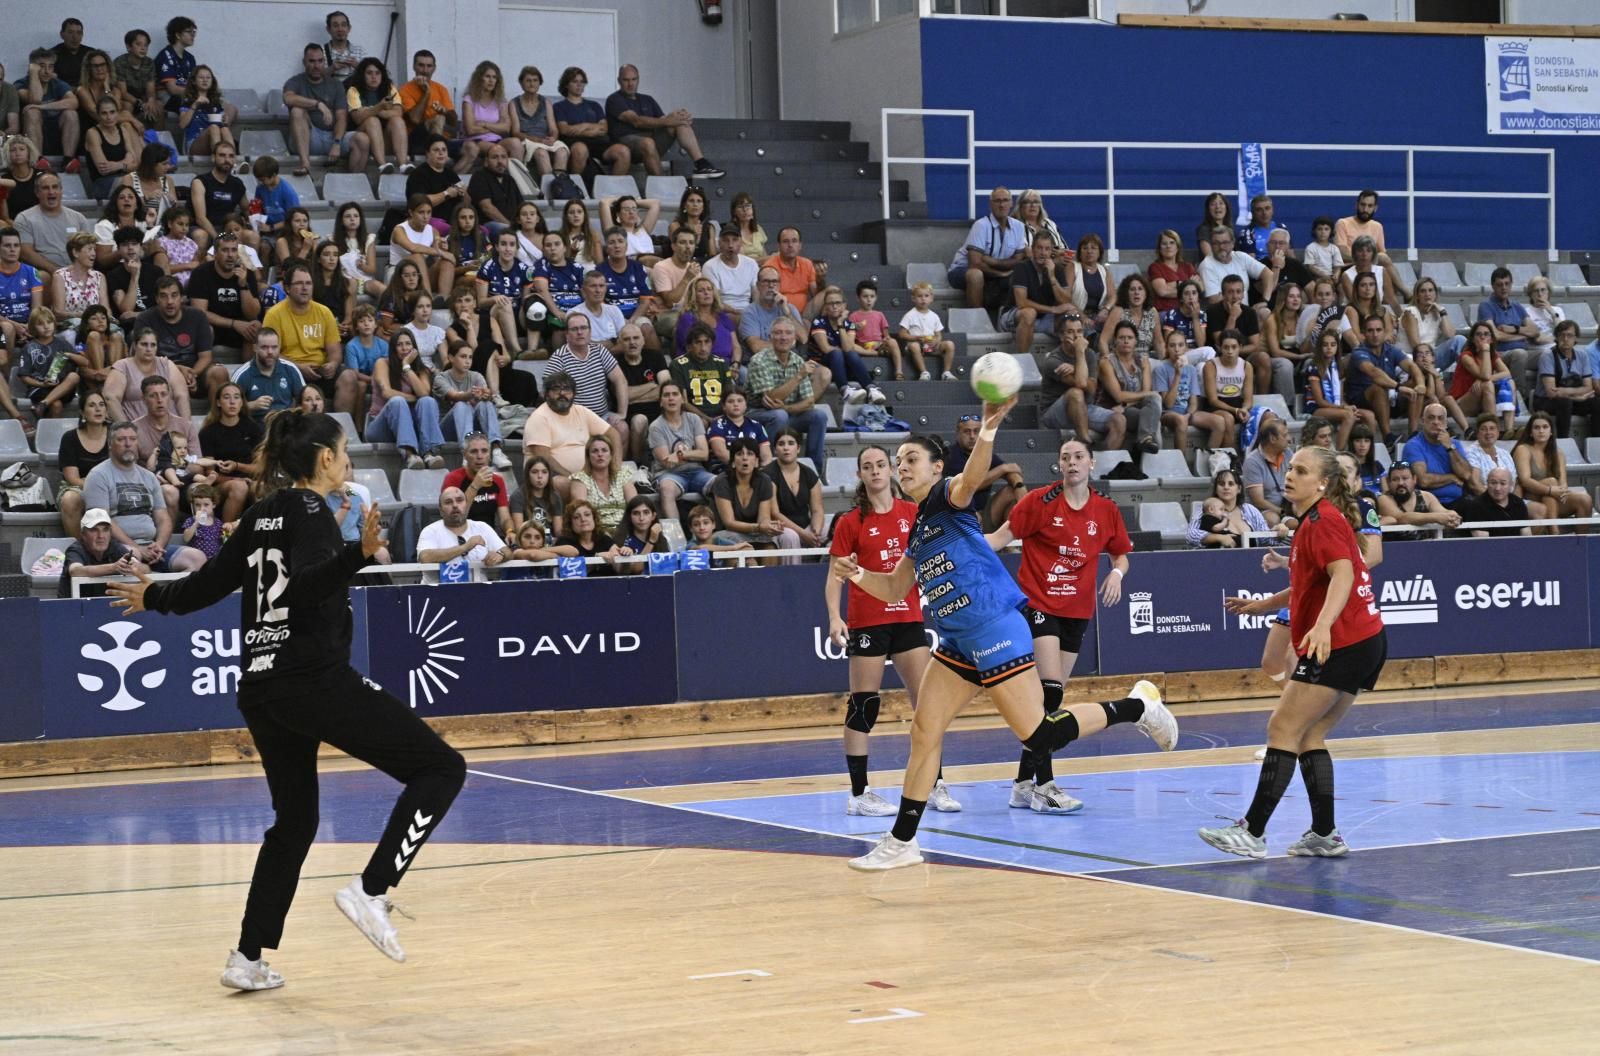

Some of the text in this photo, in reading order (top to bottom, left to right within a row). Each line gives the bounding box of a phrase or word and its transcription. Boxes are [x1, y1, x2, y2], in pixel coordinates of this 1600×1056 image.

[1534, 56, 1574, 65] DONOSTIA
[1534, 68, 1598, 78] SAN SEBASTIÁN
[1536, 83, 1588, 93] Donostia Kirola
[503, 276, 510, 287] 3
[886, 537, 899, 548] 95
[1073, 536, 1079, 545] 2
[920, 552, 945, 573] super
[924, 561, 954, 581] amara
[247, 548, 290, 622] 12
[1173, 623, 1211, 633] SEBASTIÁN
[498, 632, 641, 658] DAVID
